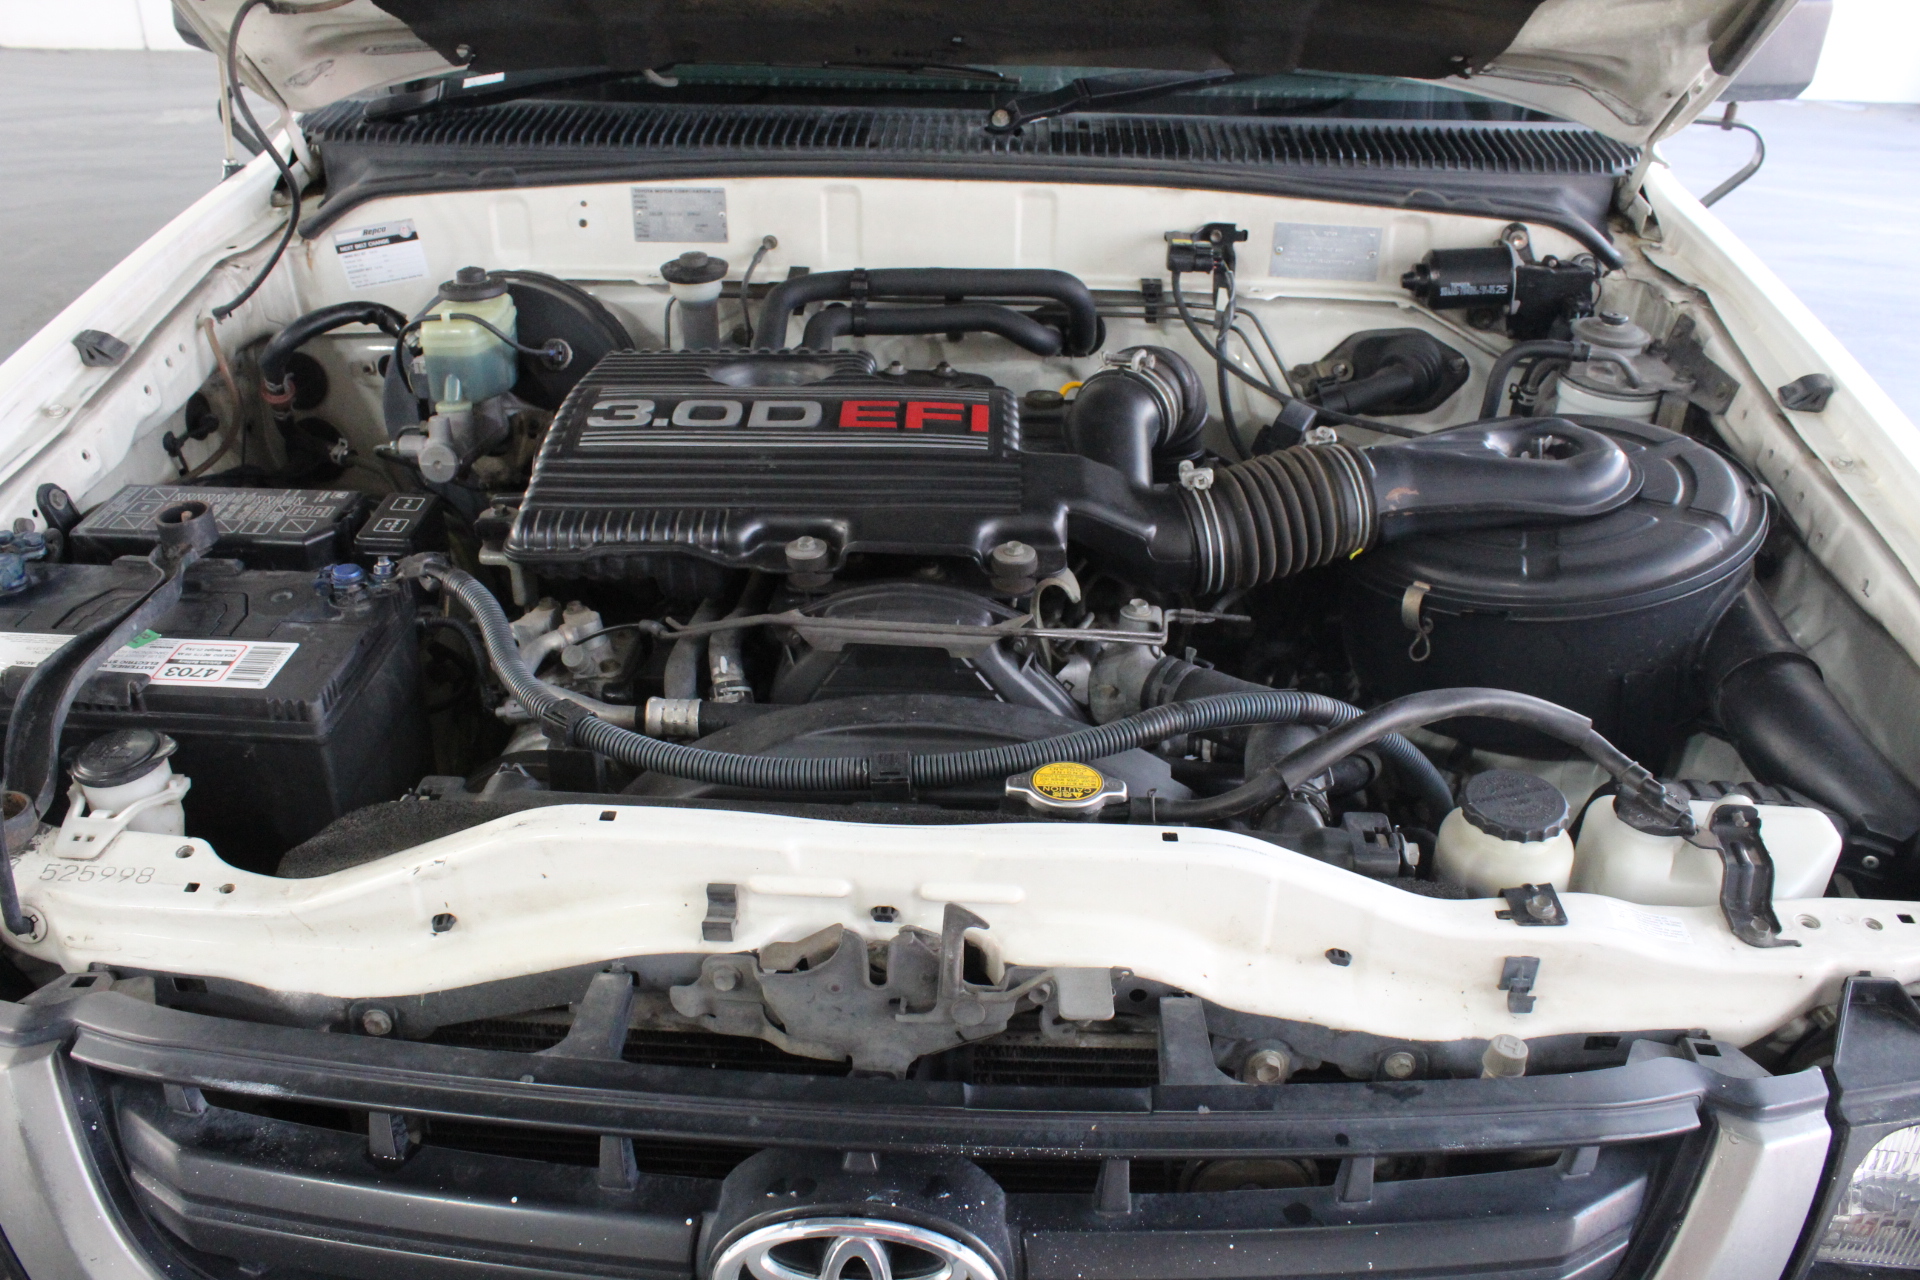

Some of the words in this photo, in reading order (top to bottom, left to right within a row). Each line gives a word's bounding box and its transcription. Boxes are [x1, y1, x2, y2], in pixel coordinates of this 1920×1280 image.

[362, 226, 387, 236] Repco
[368, 238, 390, 247] CHANGE
[586, 399, 822, 428] 3.0D
[838, 399, 990, 433] EFI
[164, 666, 219, 678] 4703
[39, 863, 156, 884] 525998
